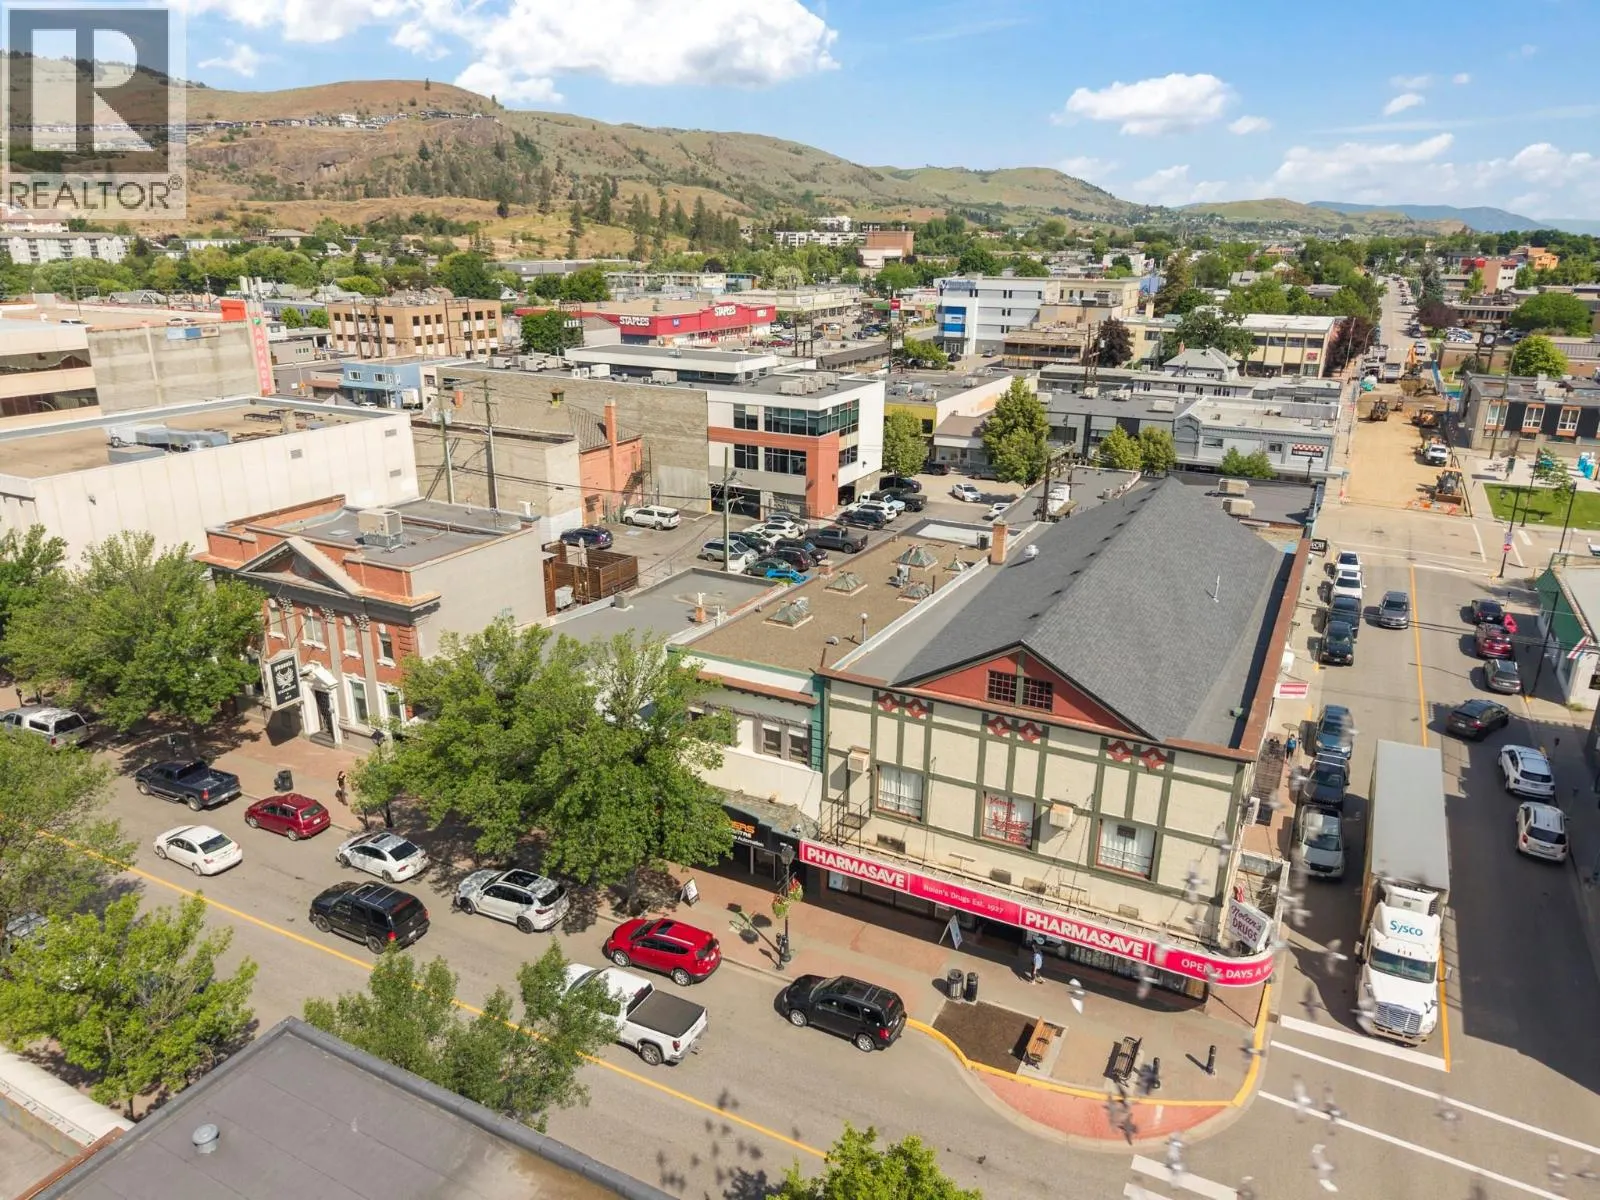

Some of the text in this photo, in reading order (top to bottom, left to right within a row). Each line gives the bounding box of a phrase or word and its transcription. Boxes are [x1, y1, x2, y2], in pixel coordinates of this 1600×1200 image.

[714, 305, 737, 317] STAPLES
[619, 315, 650, 327] STAPLES
[806, 846, 905, 888] PHARMASAVE
[987, 904, 1004, 914] 1927
[1025, 911, 1144, 958] PHARMASAVE
[1232, 917, 1258, 942] DRUGS
[1390, 920, 1424, 936] Sysco
[1226, 968, 1253, 979] DAYS
[1255, 967, 1262, 976] A
